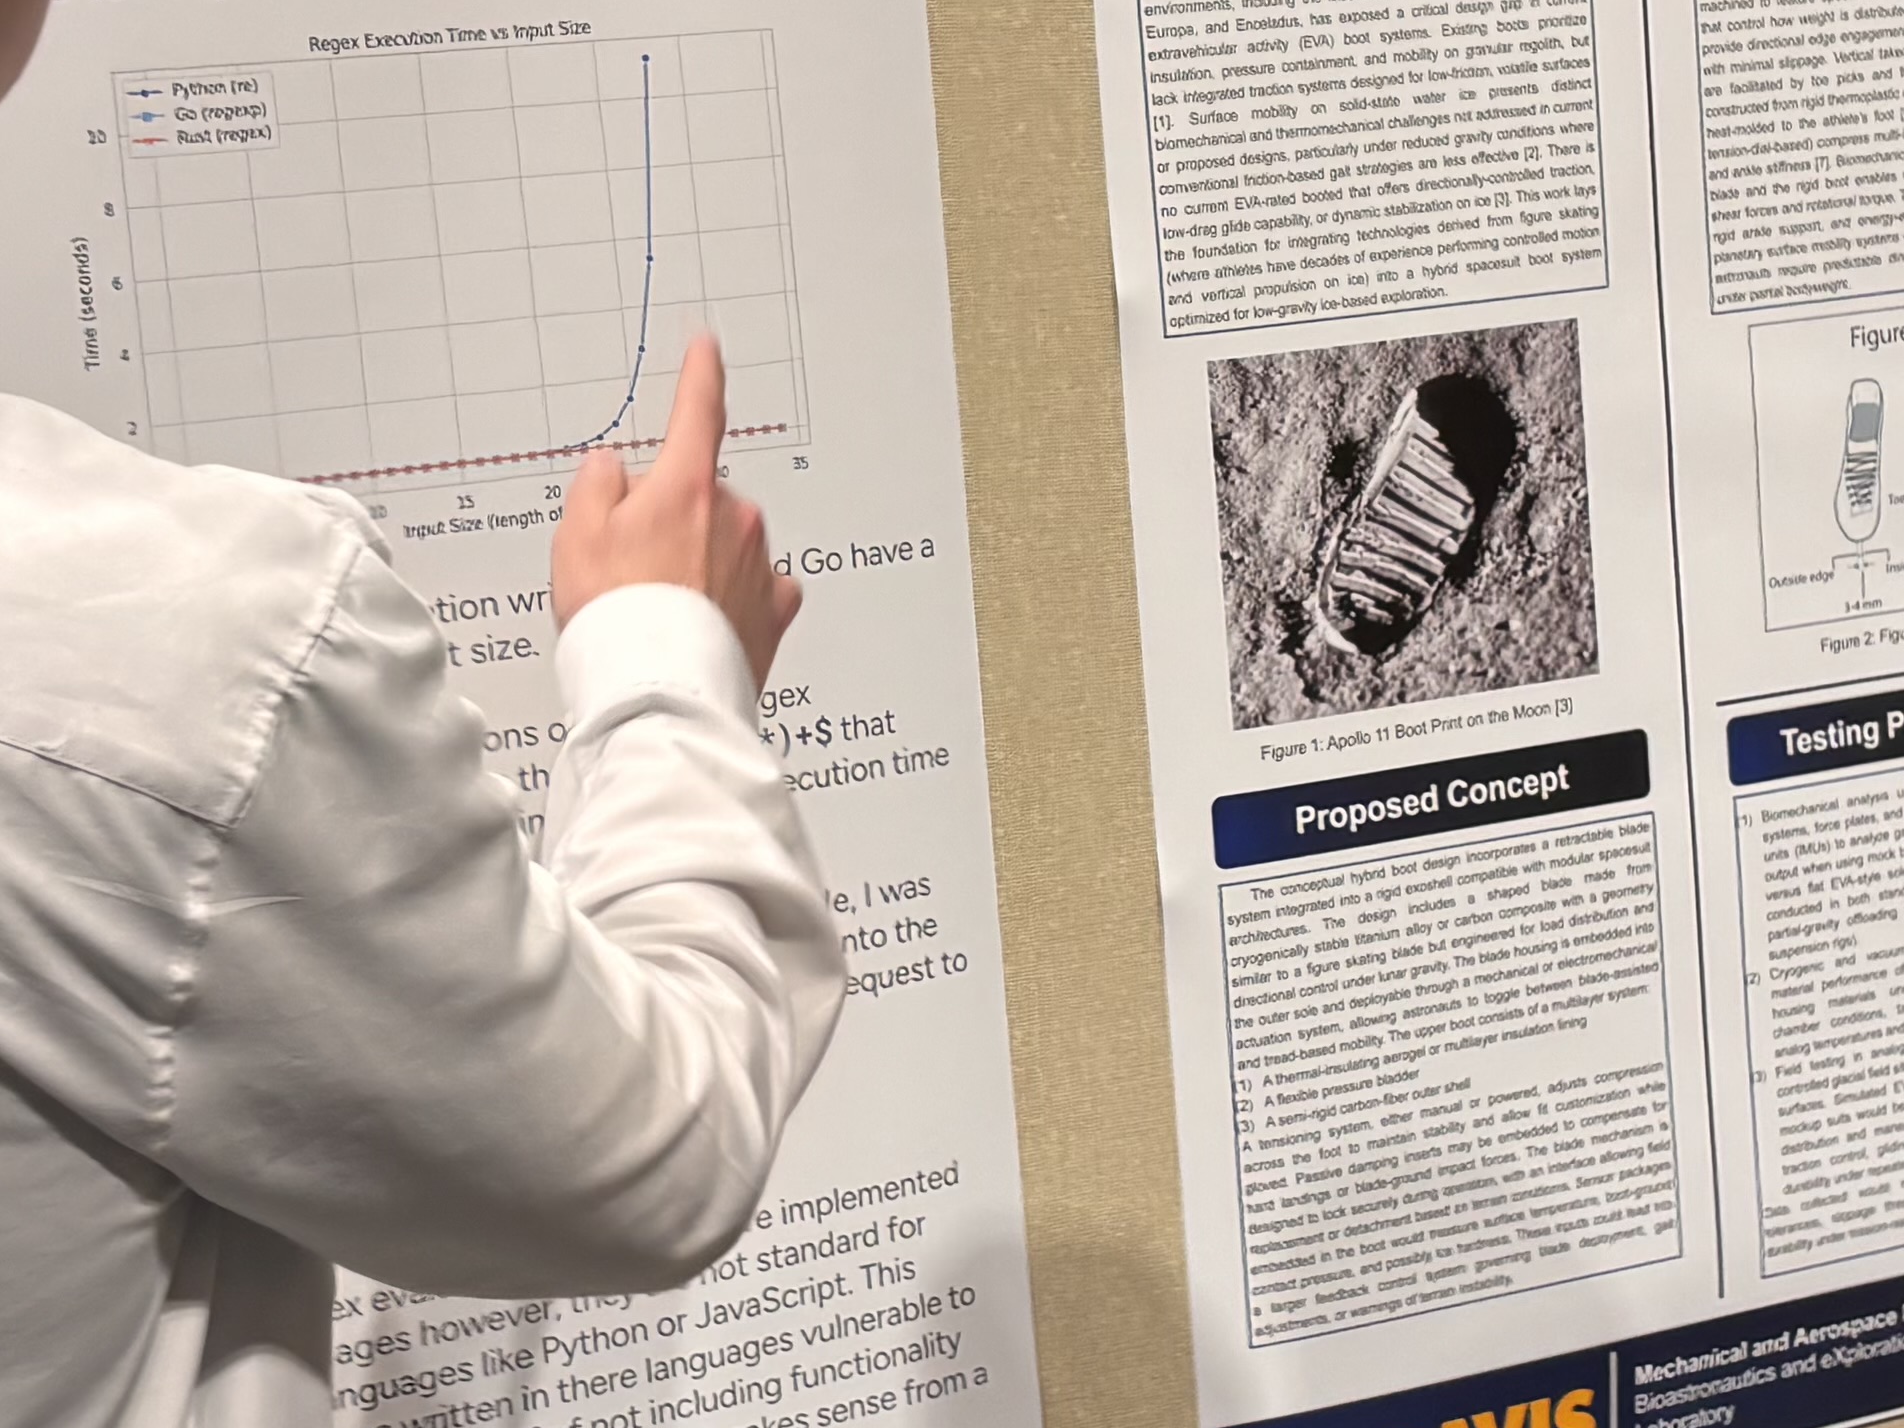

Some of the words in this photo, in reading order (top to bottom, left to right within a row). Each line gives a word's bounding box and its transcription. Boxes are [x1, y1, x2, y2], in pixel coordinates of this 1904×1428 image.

[309, 31, 360, 55] Regex
[365, 28, 443, 50] Execution
[447, 26, 487, 44] Time
[513, 22, 554, 40] Input
[558, 20, 592, 37] Size
[1189, 109, 1239, 124] Surface
[1251, 103, 1298, 121] mobility
[72, 237, 95, 322] (seconds)
[84, 328, 100, 370] Time
[544, 484, 562, 500] 20
[793, 456, 810, 471] 35
[801, 550, 844, 573] Go
[850, 543, 914, 570] have
[920, 538, 935, 558] a
[472, 636, 539, 665] size.
[1820, 635, 1862, 655] Figure
[1865, 632, 1876, 648] 2:
[1261, 739, 1308, 762] Figure
[1312, 738, 1325, 753] 1:
[1327, 729, 1372, 751] Apollo
[1376, 727, 1391, 741] 11
[1395, 721, 1427, 739] Boot
[1431, 715, 1463, 734] Print
[1467, 713, 1484, 726] on
[1488, 709, 1509, 723] the
[1513, 701, 1551, 718] Moon
[1555, 697, 1574, 715] [3]
[1780, 717, 1880, 758] Testing
[1296, 784, 1440, 835] Proposed
[1447, 762, 1570, 808] Concept
[779, 1162, 960, 1227] implemented
[541, 1323, 648, 1368] Python
[656, 1315, 687, 1338] or
[695, 1281, 854, 1331] JavaScript.
[860, 1257, 917, 1289] This
[644, 1338, 794, 1383] languages
[800, 1298, 943, 1346] vulnerable
[949, 1283, 976, 1308] to
[790, 1328, 962, 1388] functionality
[1634, 1342, 1748, 1386] Mechanical
[1754, 1337, 1788, 1361] and
[1794, 1308, 1898, 1351] Aerospace
[1634, 1360, 1776, 1415] Bioastronautics
[1780, 1355, 1816, 1379] and
